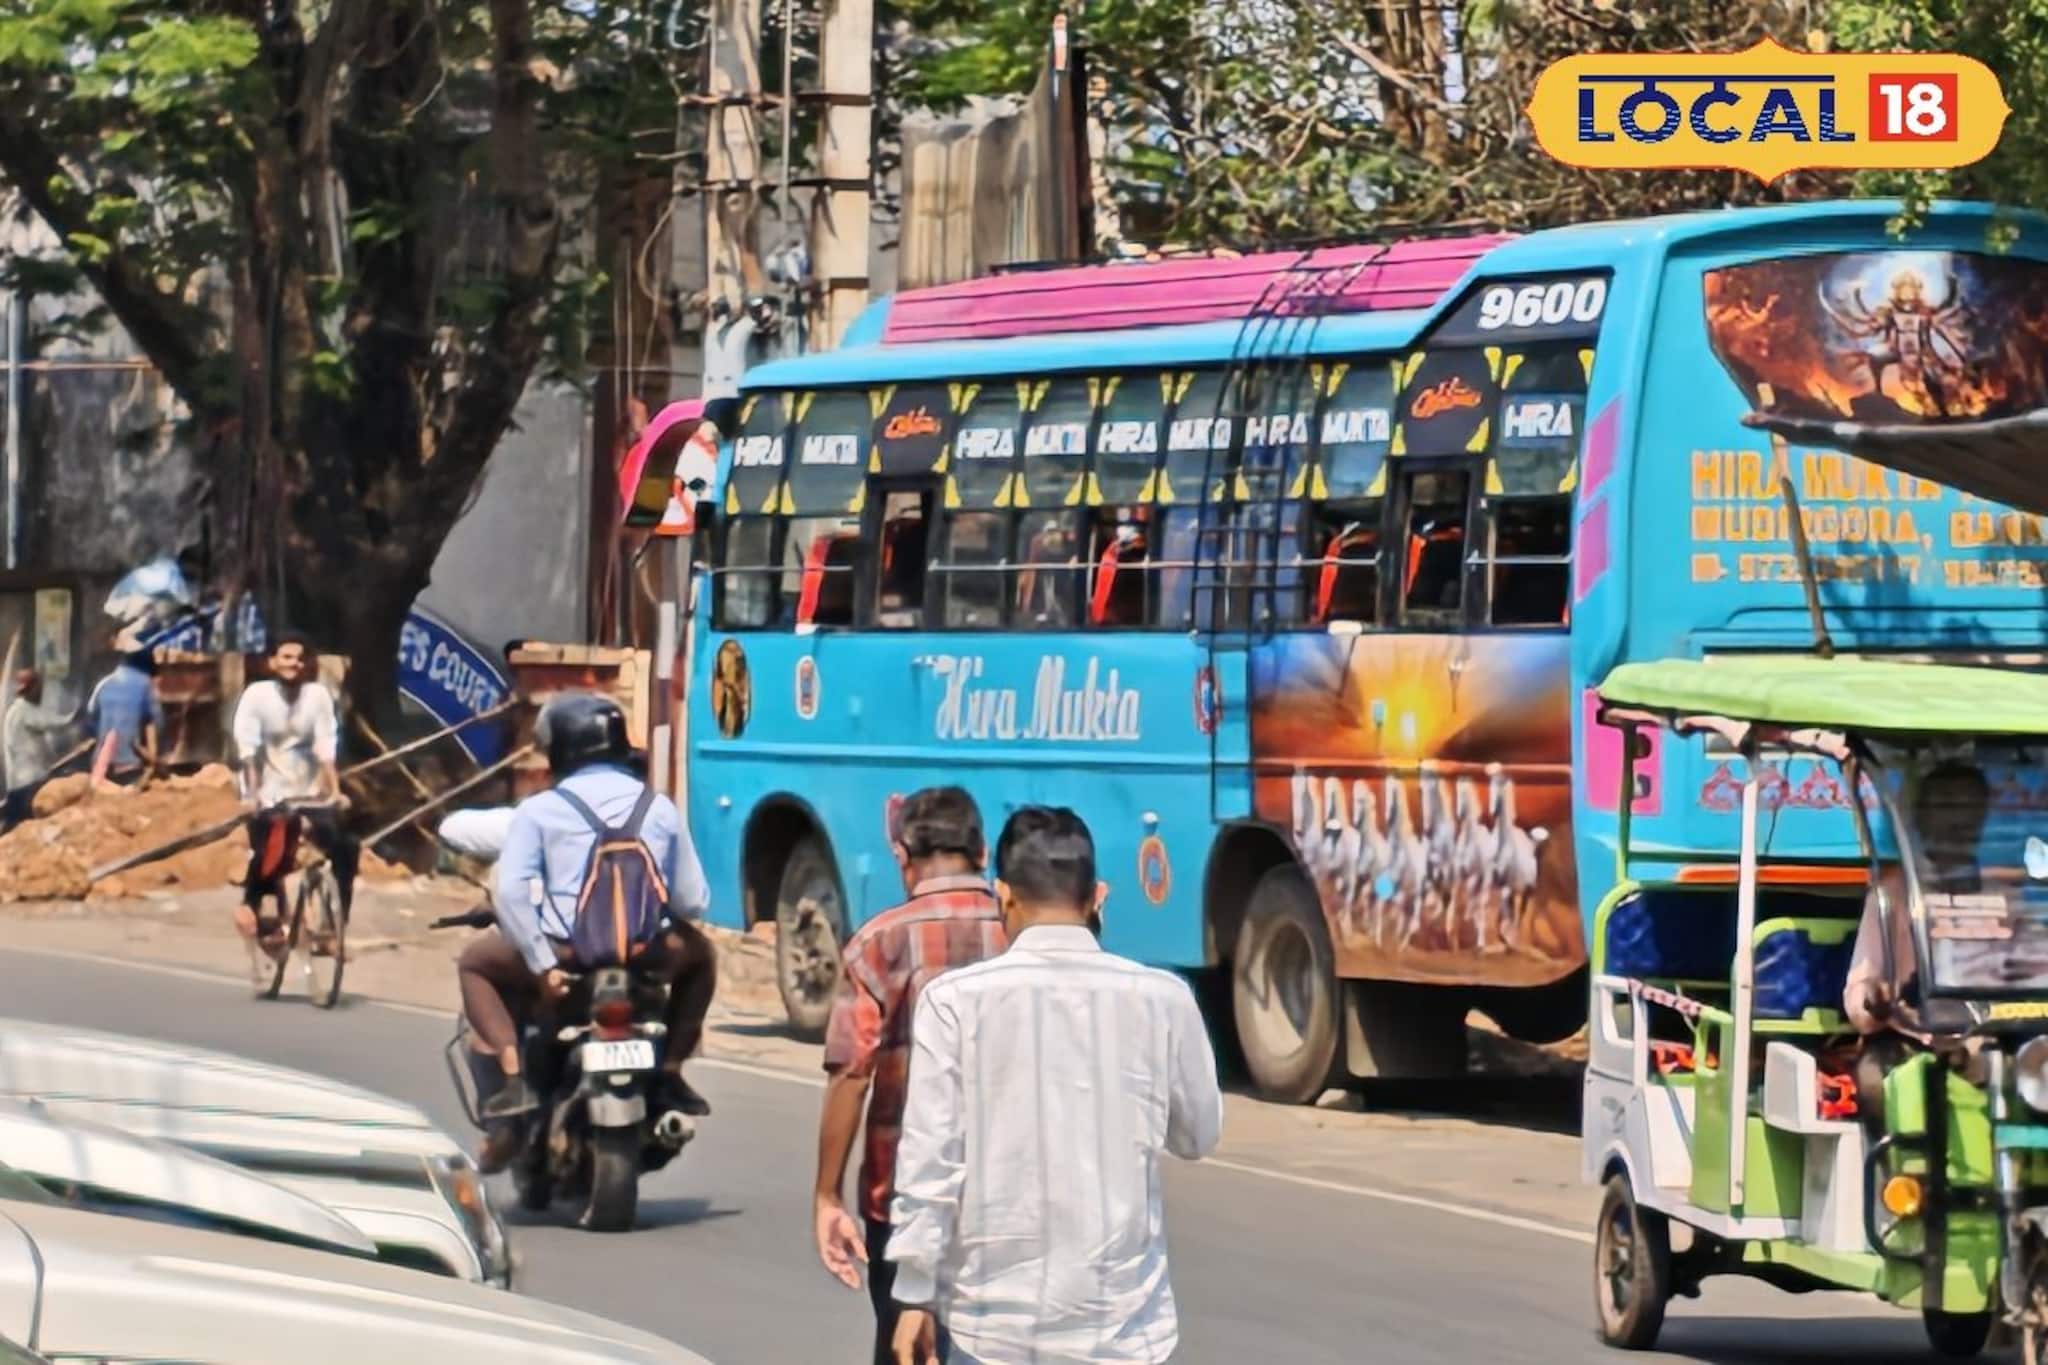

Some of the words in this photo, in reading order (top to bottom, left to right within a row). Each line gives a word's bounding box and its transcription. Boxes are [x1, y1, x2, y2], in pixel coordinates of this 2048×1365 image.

[1477, 280, 1606, 330] 9600
[1244, 411, 1308, 447] HRA
[1023, 655, 1141, 741] Mukta
